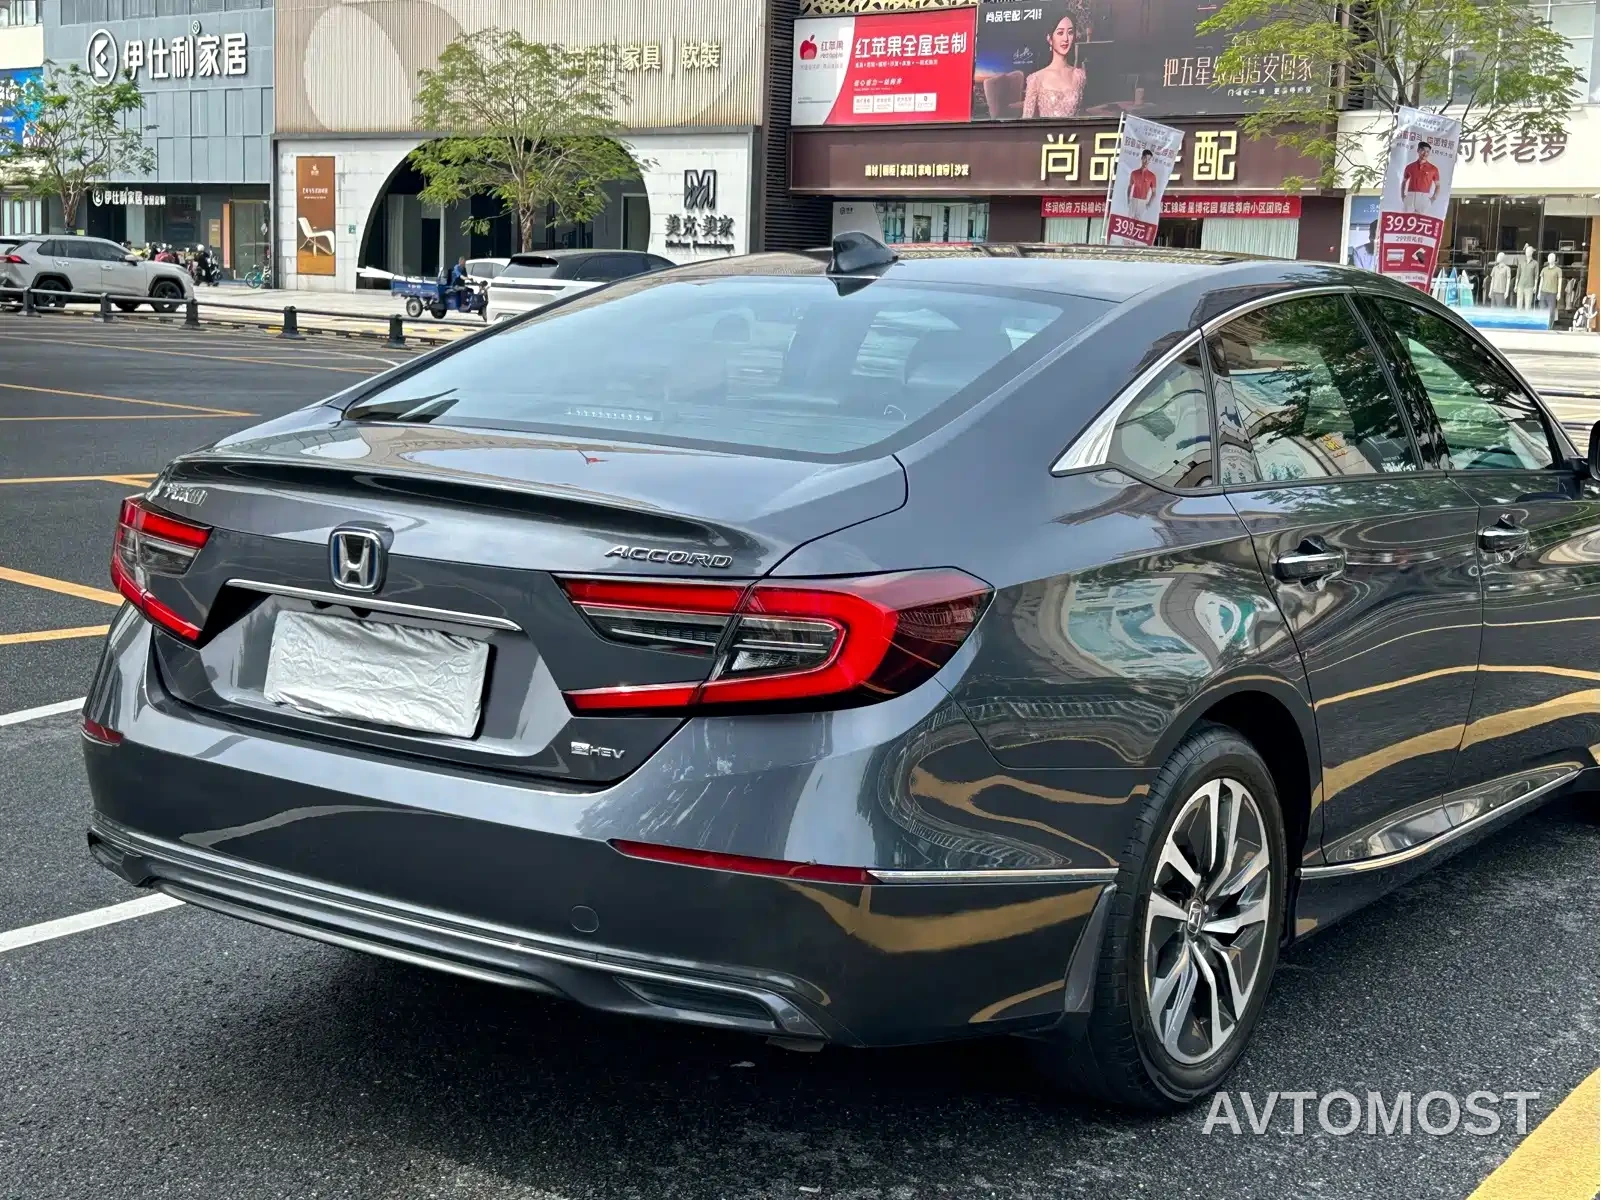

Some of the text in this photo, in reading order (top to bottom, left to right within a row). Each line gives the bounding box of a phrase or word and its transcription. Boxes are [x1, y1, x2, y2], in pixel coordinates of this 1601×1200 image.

[986, 11, 1020, 23] 尚品宅配
[123, 32, 248, 80] 伊仕利家居
[622, 44, 661, 70] 家具
[855, 32, 967, 58] 红苹果全屋定制
[1041, 131, 1237, 181] 尚品配
[1458, 133, 1568, 164] 衬衫老罗
[1385, 215, 1432, 235] 39.9元
[604, 545, 733, 569] ACCORD
